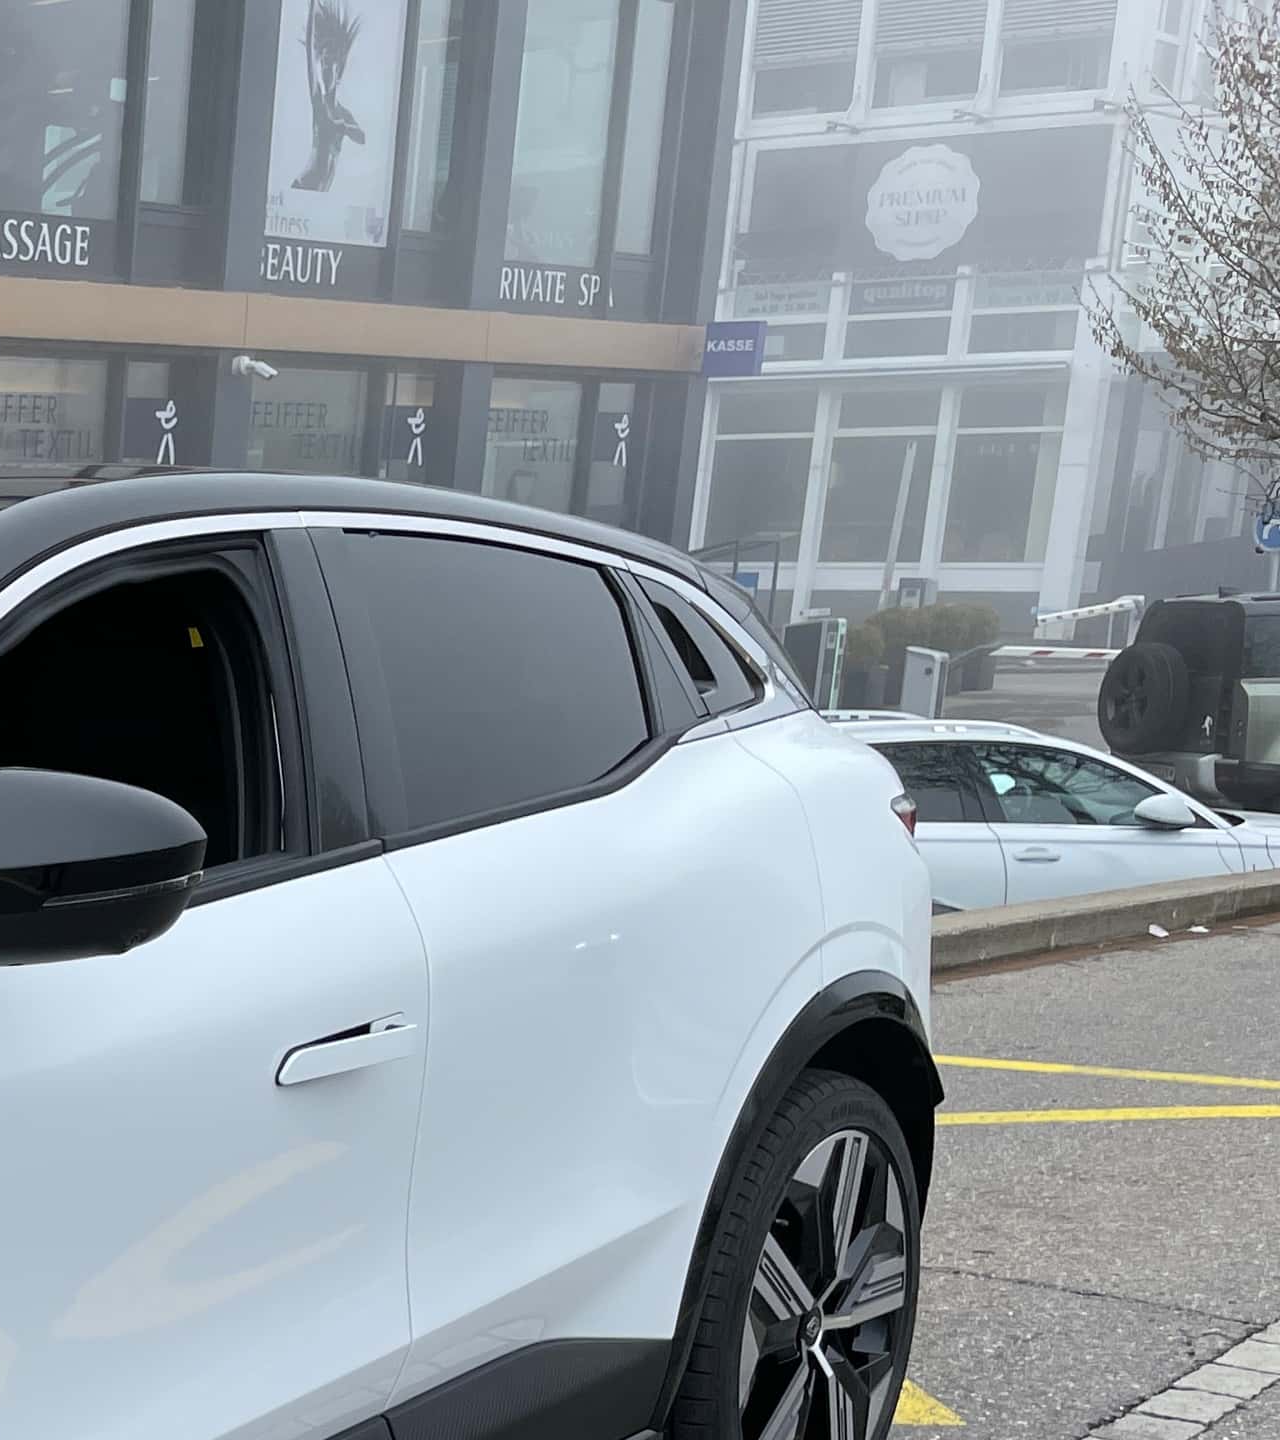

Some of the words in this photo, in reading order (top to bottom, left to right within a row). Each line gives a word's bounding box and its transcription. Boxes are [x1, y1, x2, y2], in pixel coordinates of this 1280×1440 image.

[260, 243, 343, 285] EAUTY
[499, 266, 566, 304] RIVATE
[706, 338, 755, 353] KASSE
[17, 428, 94, 459] TEXTIL
